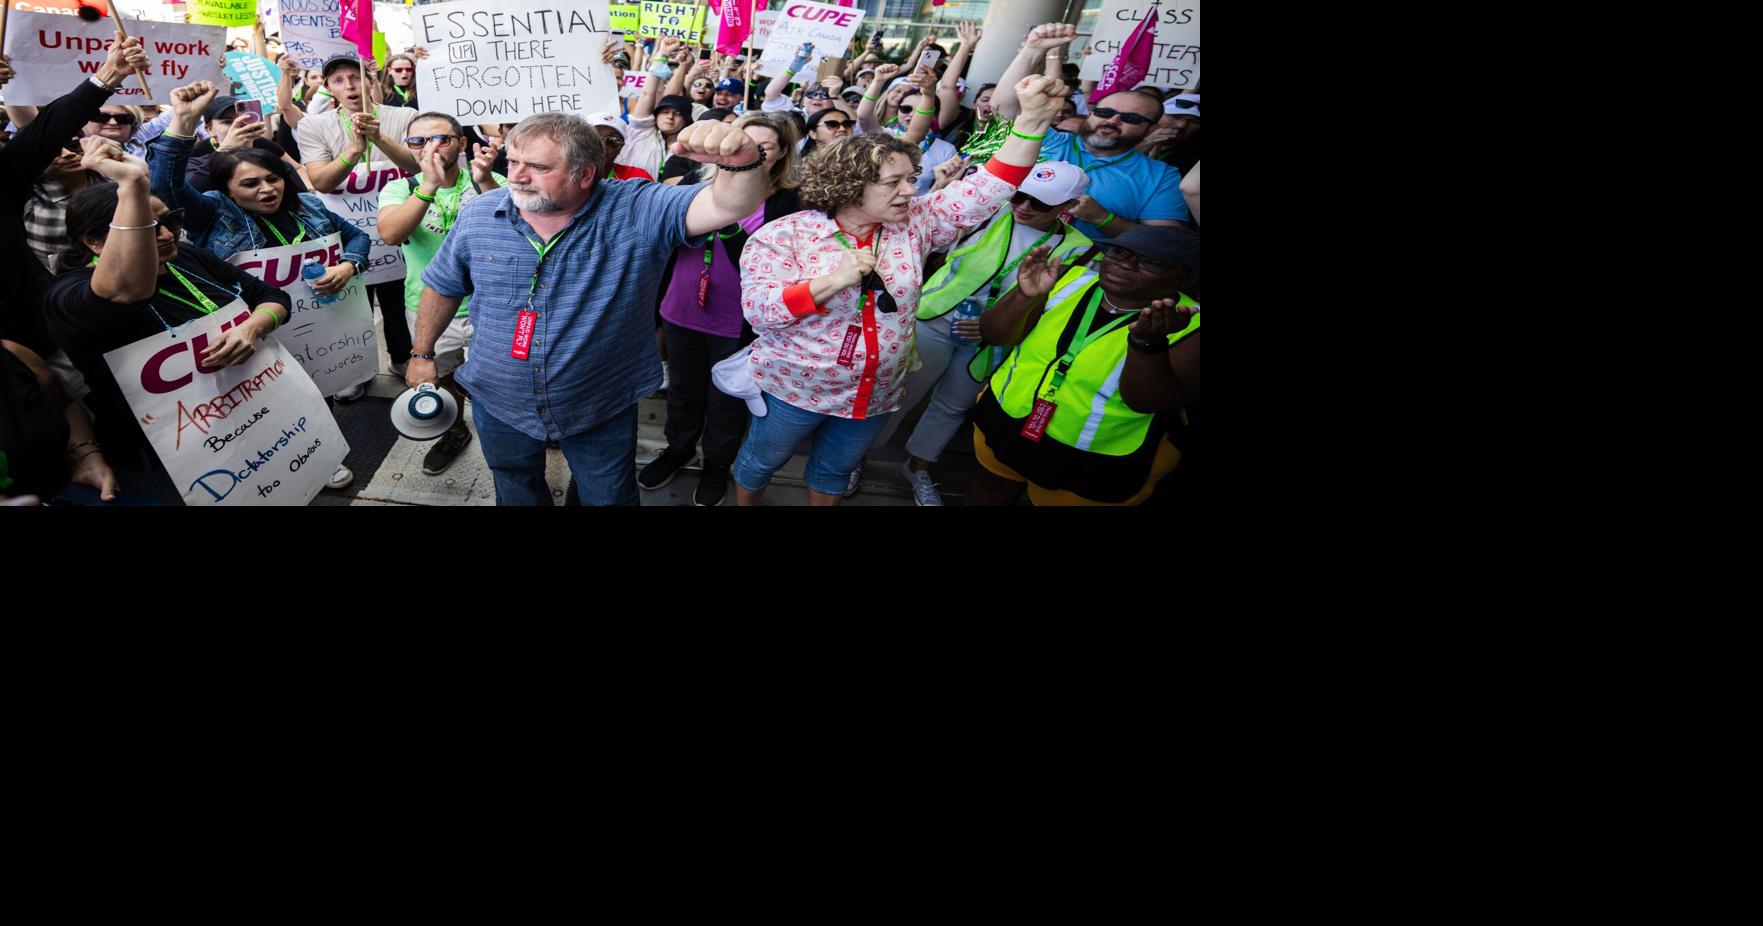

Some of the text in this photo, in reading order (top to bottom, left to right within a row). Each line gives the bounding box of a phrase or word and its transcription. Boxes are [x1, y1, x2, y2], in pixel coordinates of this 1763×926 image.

[644, 3, 699, 17] RIGHT
[658, 15, 680, 25] TO
[787, 5, 857, 27] CUPE
[1116, 9, 1193, 25] CLSS
[282, 14, 336, 28] AGENTS
[422, 9, 609, 43] ESSENTIAL
[641, 25, 698, 41] STRIKE
[155, 40, 210, 56] work
[284, 41, 314, 55] PAS
[487, 40, 555, 61] THERE
[161, 60, 189, 80] fly
[432, 64, 592, 91] FORGOTTEN
[456, 93, 583, 117] DOWN HERE
[323, 353, 364, 375] words
[203, 406, 270, 453] Because
[189, 416, 308, 503] Dictatorship
[257, 438, 322, 498] too Obvious
